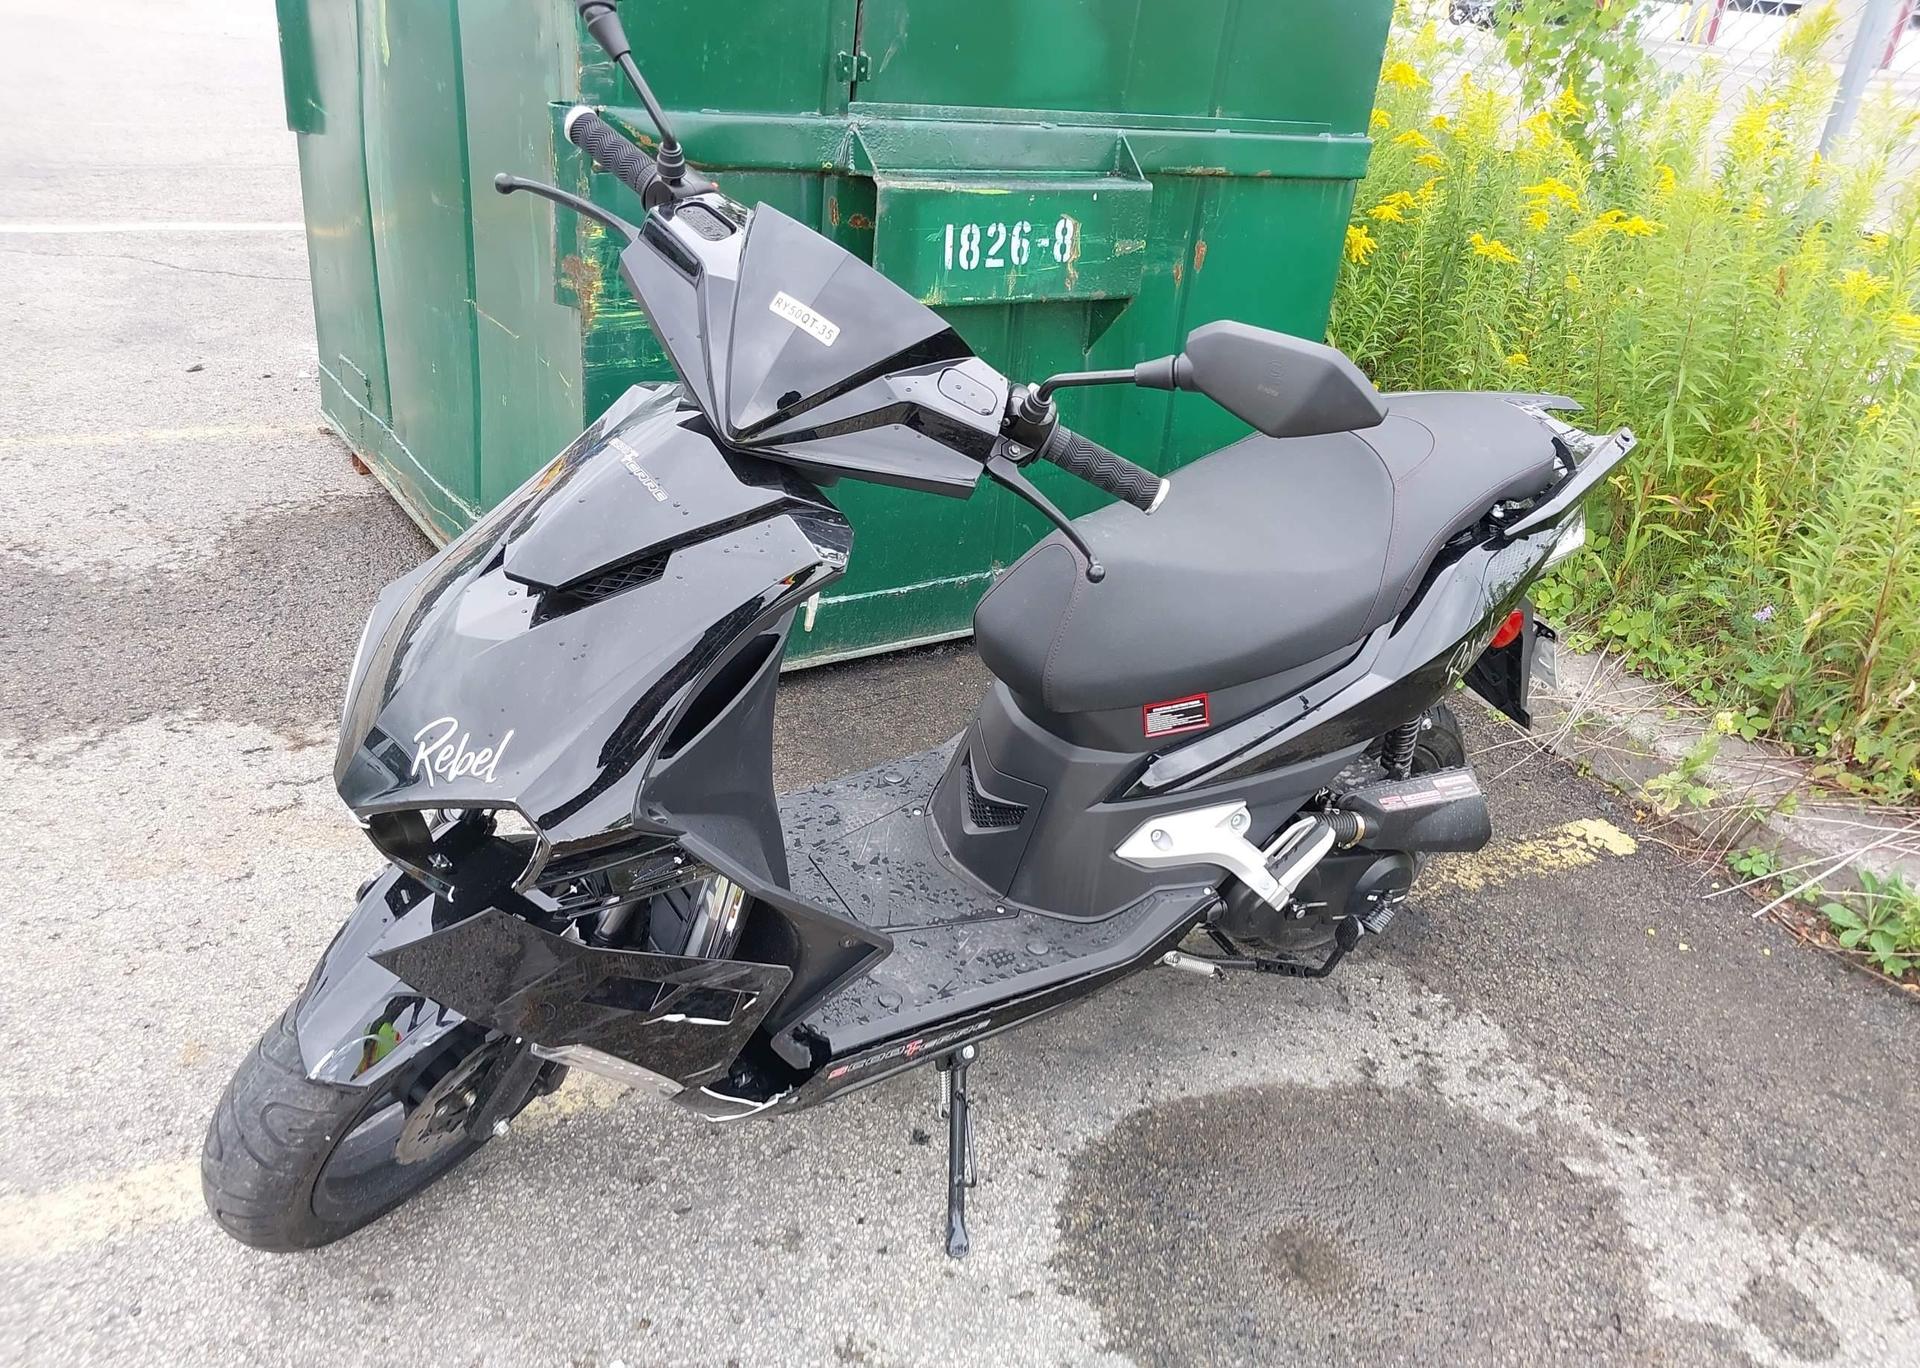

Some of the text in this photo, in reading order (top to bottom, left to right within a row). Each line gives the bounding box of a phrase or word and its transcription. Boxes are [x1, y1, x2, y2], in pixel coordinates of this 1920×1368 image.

[944, 217, 1076, 270] 1826-8
[774, 297, 834, 340] RY50QT-35
[412, 716, 514, 787] Rebel
